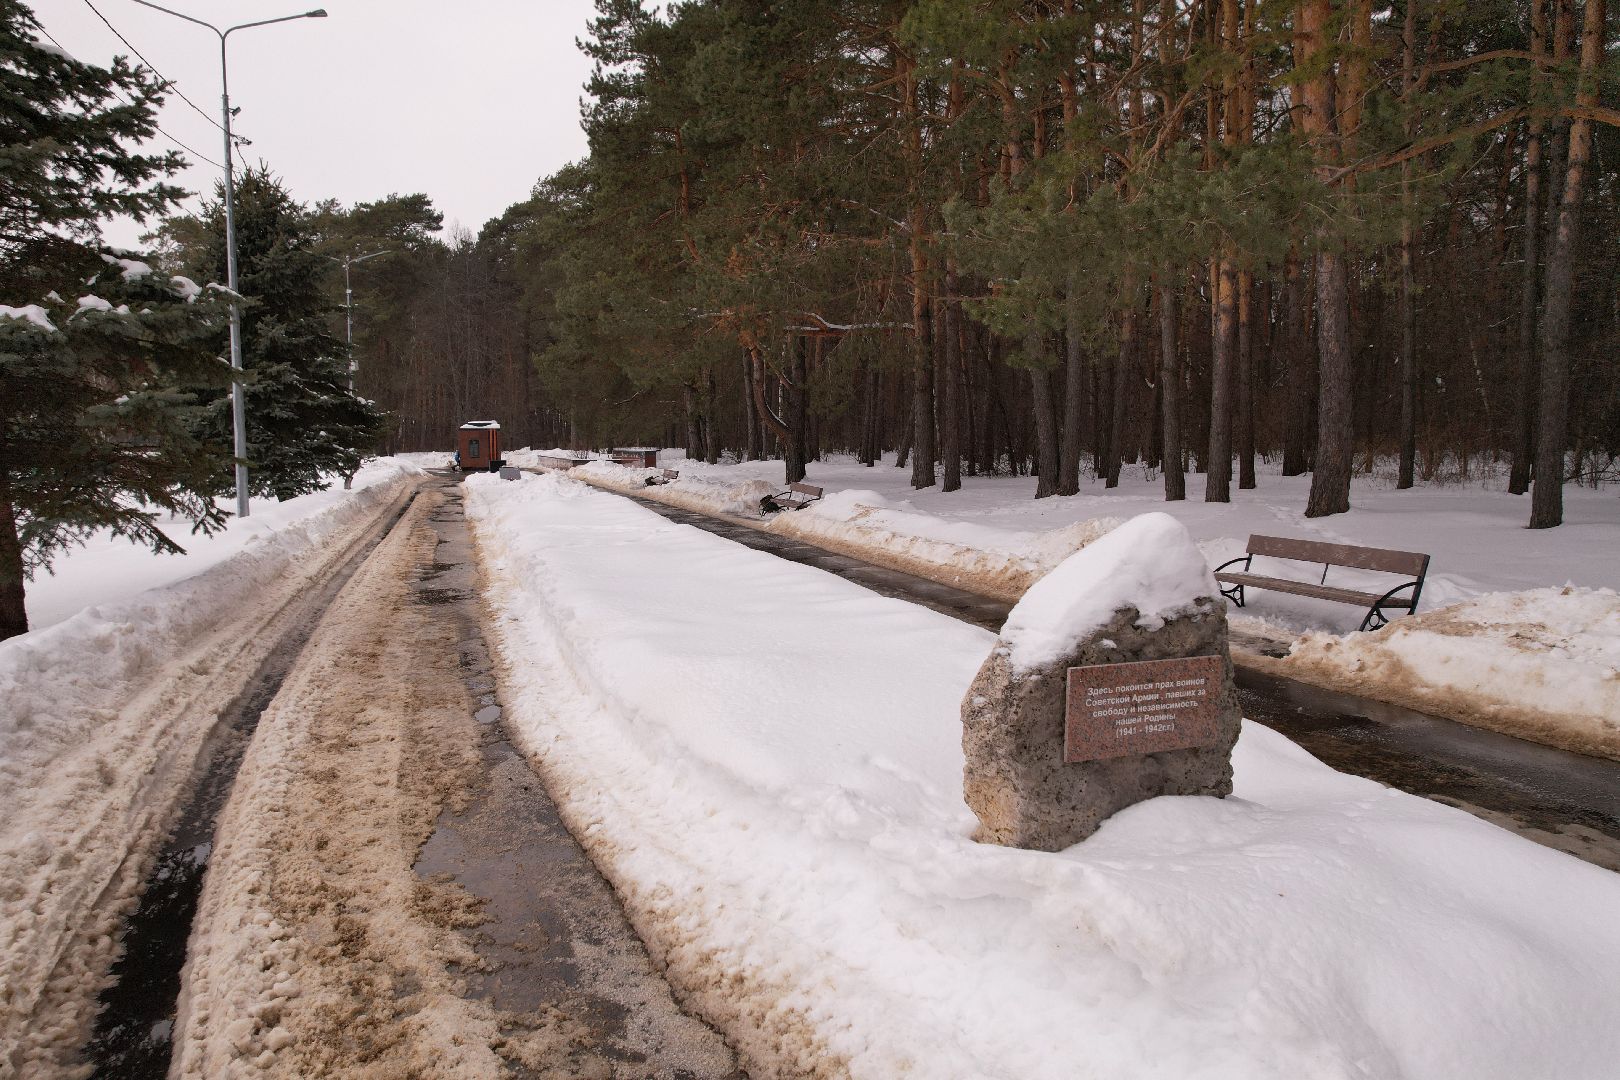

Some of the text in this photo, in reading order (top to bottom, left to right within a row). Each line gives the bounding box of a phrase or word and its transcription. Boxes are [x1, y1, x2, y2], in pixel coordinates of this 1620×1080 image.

[1087, 678, 1205, 697] Здесь покоится прах воинов
[1085, 695, 1130, 707] Советской
[1165, 689, 1196, 699] павших
[1092, 707, 1128, 718] свободу
[1137, 700, 1199, 713] независимость
[1115, 713, 1176, 726] нашей Родины
[1116, 726, 1137, 738] (1941
